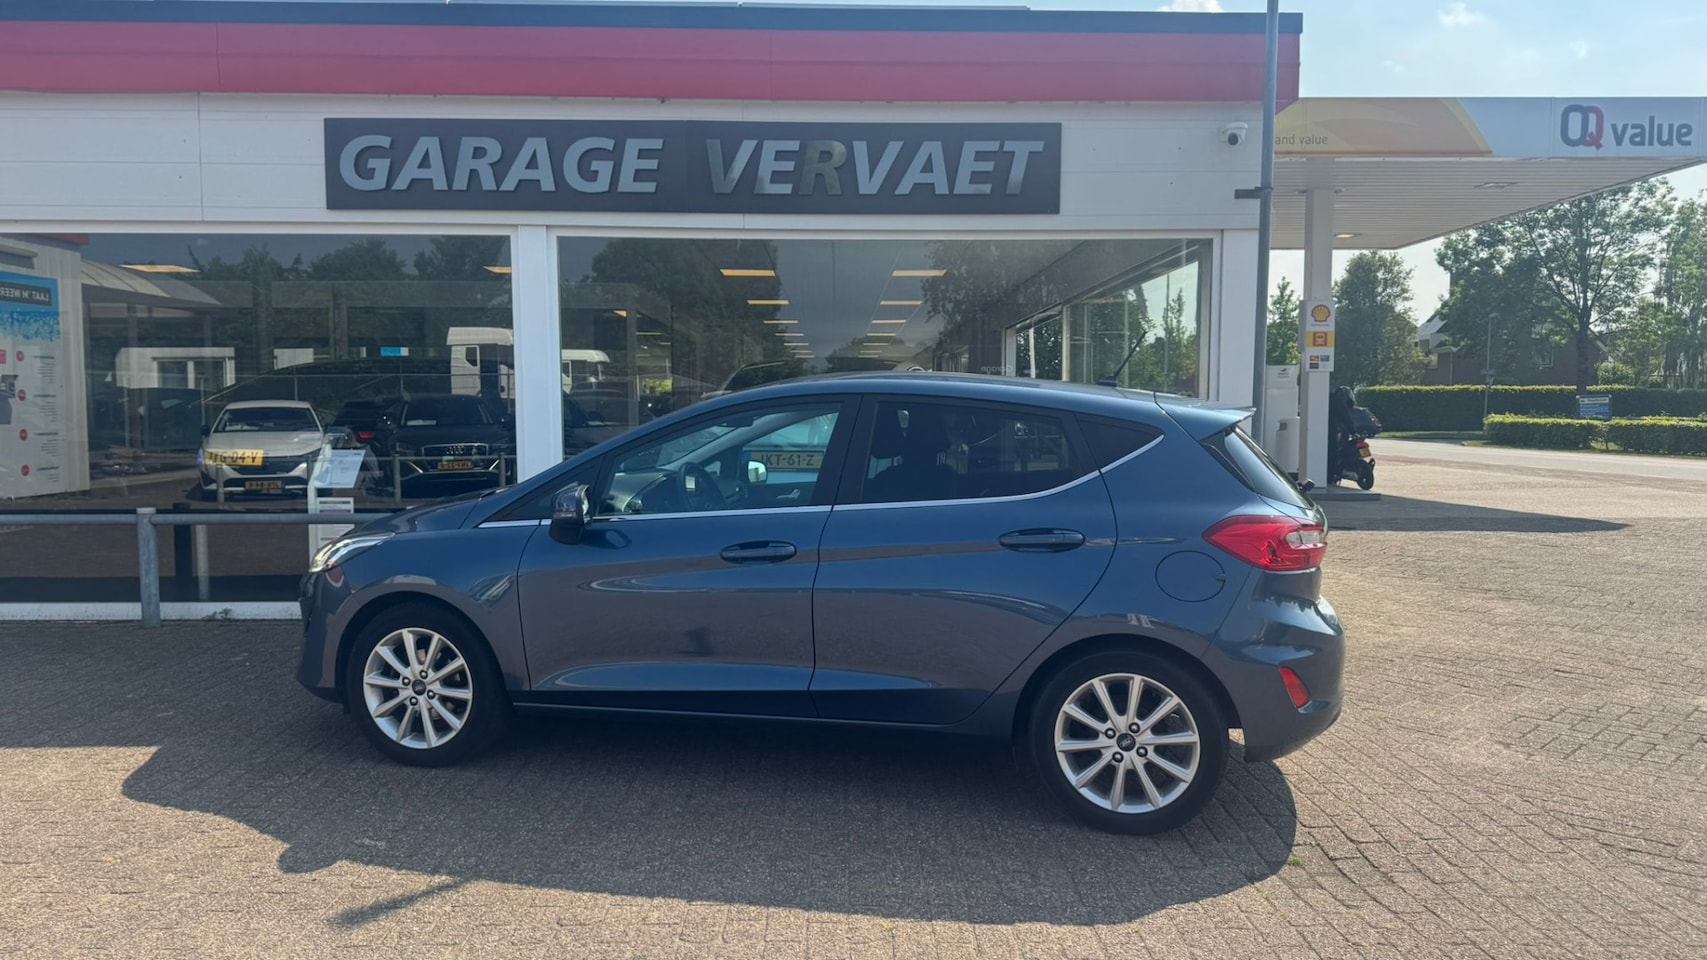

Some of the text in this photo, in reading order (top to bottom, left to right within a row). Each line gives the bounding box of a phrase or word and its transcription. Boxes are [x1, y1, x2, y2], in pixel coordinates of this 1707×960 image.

[1274, 133, 1329, 145] and value
[1610, 115, 1693, 147] value
[338, 134, 1045, 196] GARAGE VERVAET
